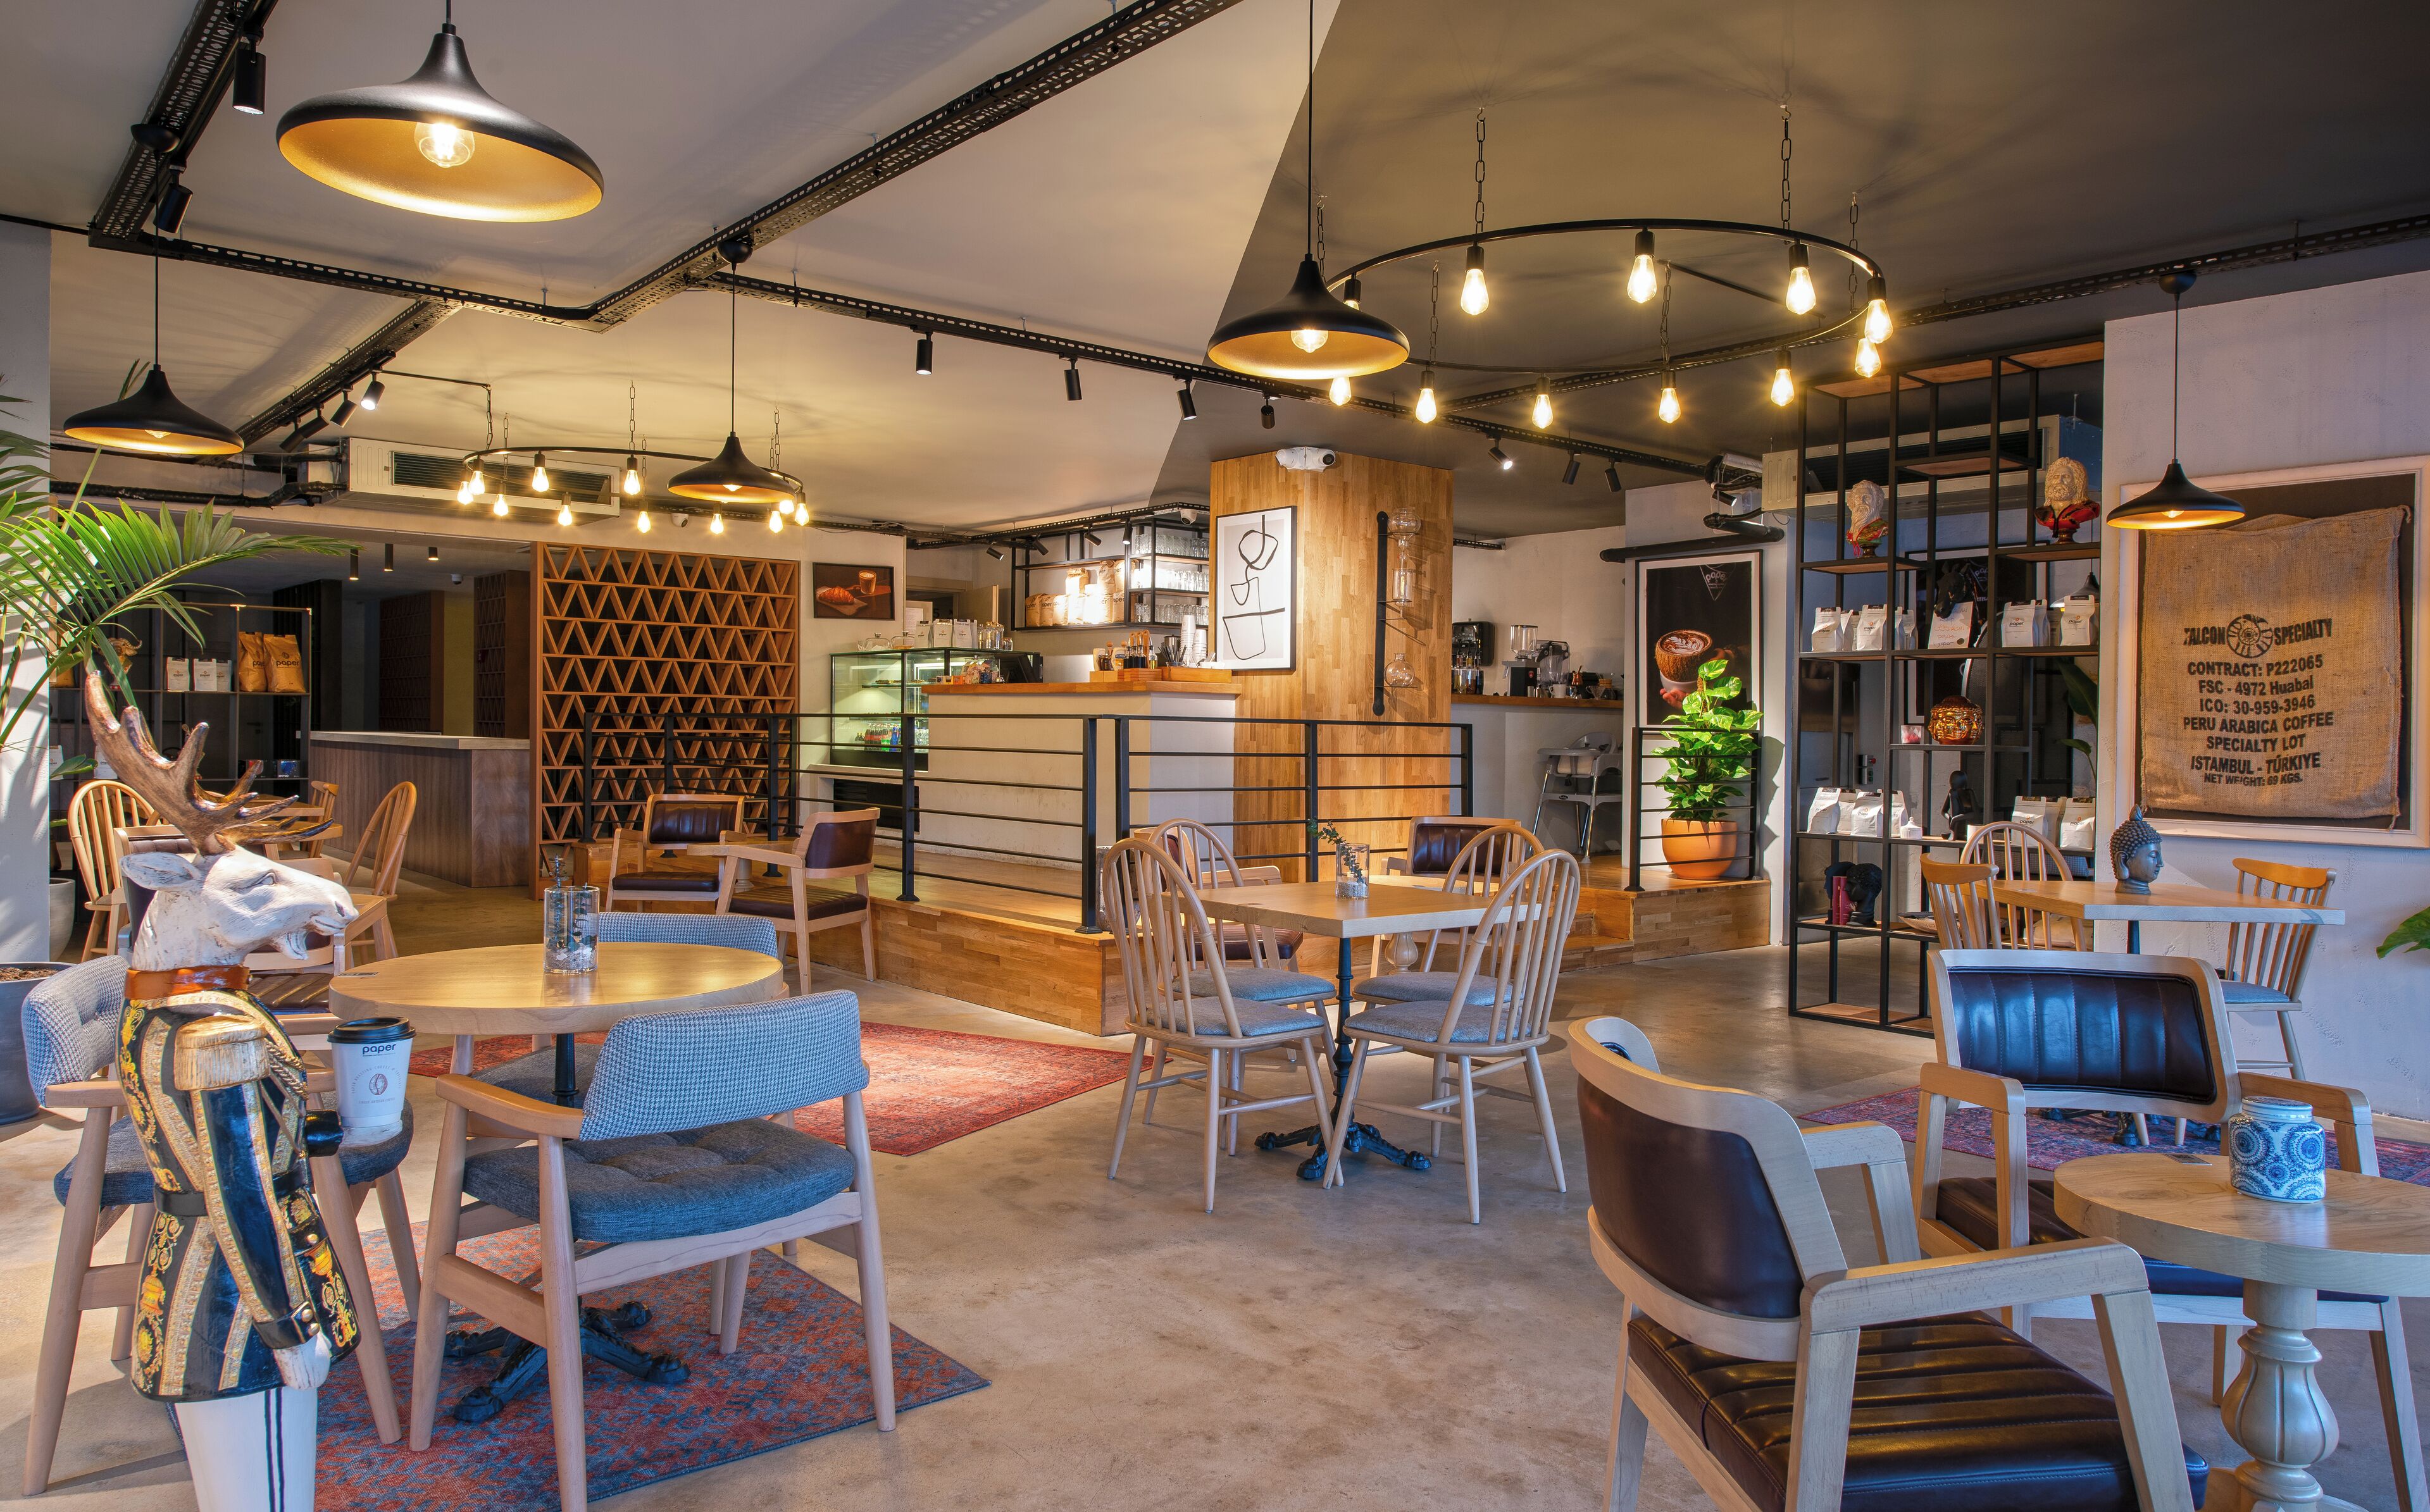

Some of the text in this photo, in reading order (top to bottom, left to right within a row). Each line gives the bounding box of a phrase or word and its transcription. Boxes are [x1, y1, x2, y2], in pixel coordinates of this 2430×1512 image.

[2274, 617, 2333, 646] SPECIALTY
[2187, 653, 2324, 677] CONTRACT: P222065
[2198, 679, 2224, 694] FSC
[2234, 681, 2267, 696] 4972
[2269, 675, 2314, 695] Huabal
[2199, 695, 2316, 715] ICO: 30-959-3946
[2183, 711, 2334, 734] PERU ARABICA COFFEE
[2206, 733, 2307, 753] SPECIALTY LOT
[2191, 755, 2254, 775] ISTAMBUL
[2203, 772, 2303, 787] NET WEIGHT: 69 KGS.
[362, 1044, 397, 1055] paper
